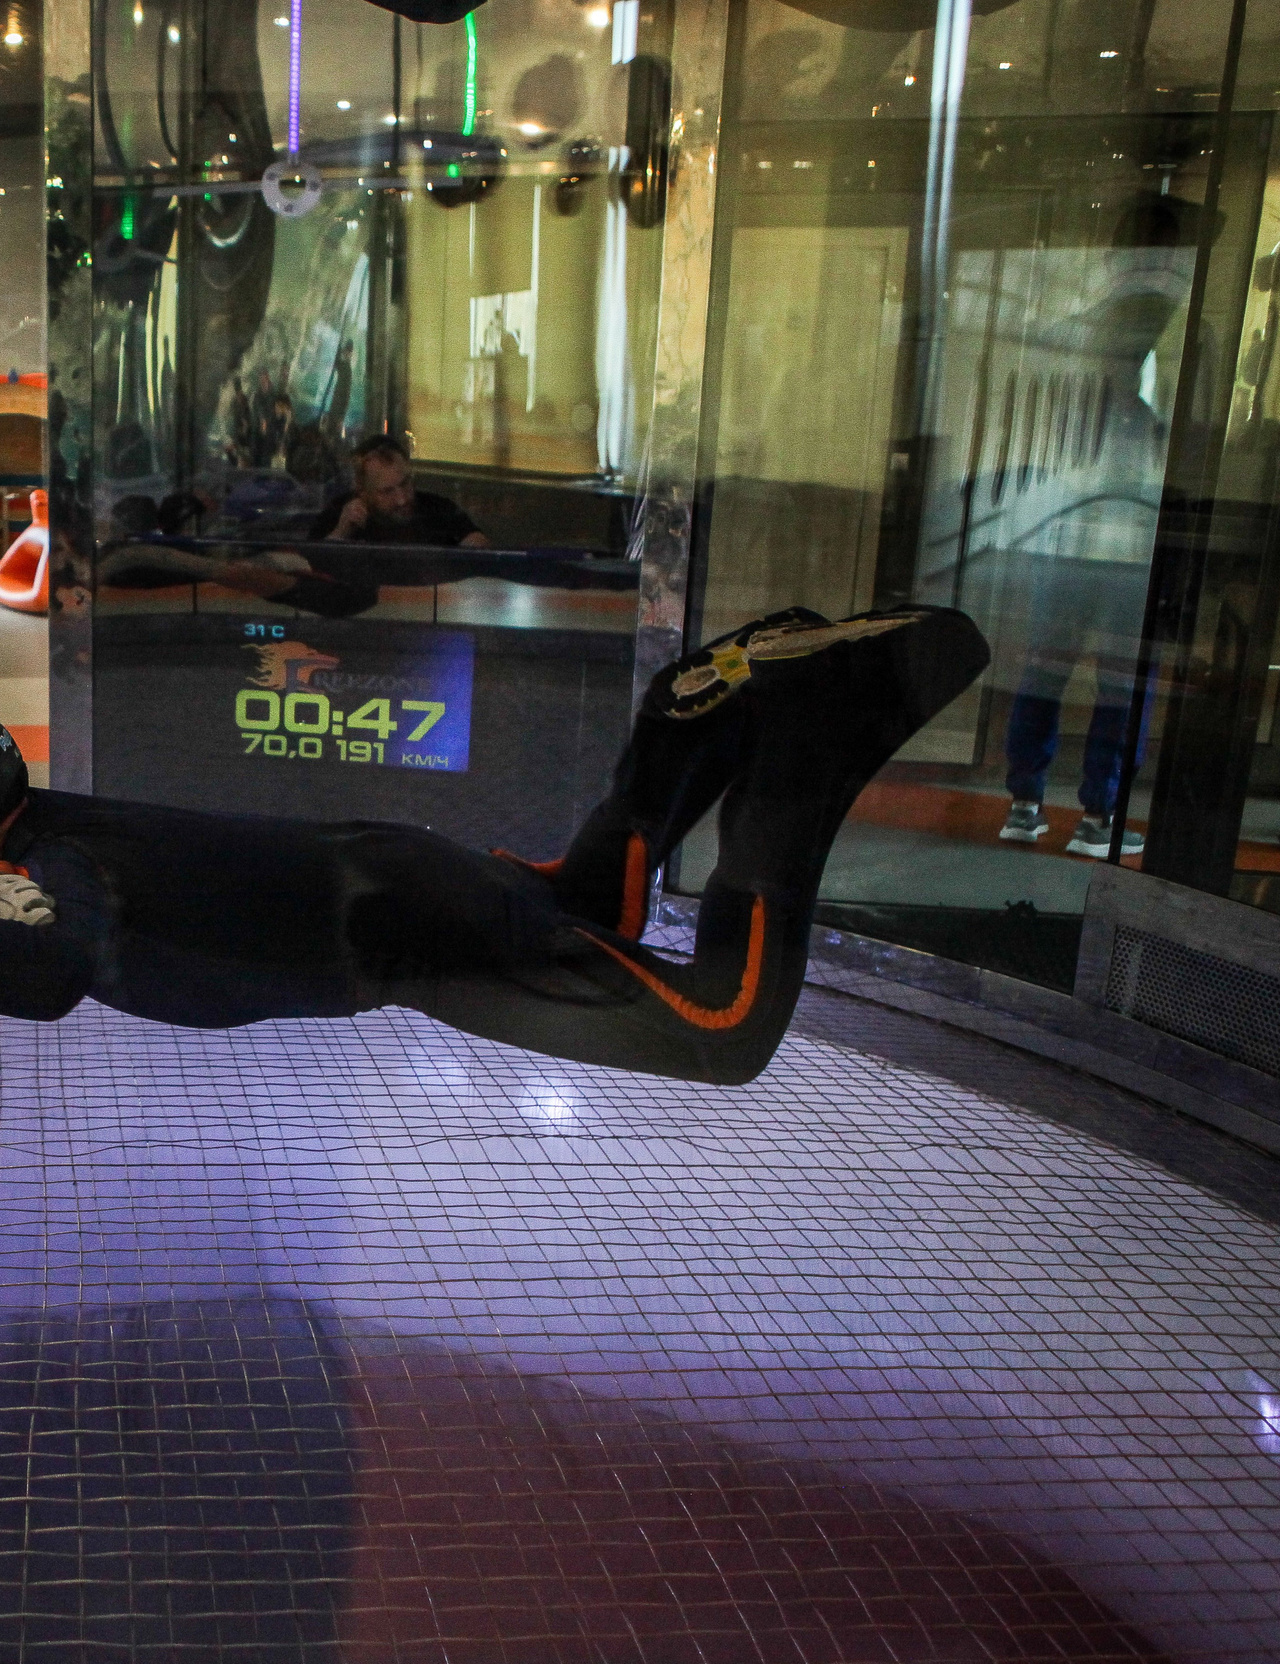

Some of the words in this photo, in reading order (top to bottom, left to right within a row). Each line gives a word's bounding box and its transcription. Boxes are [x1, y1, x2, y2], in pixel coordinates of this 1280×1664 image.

[235, 689, 446, 741] 00:47
[241, 733, 322, 758] 70,0
[336, 739, 384, 763] 191
